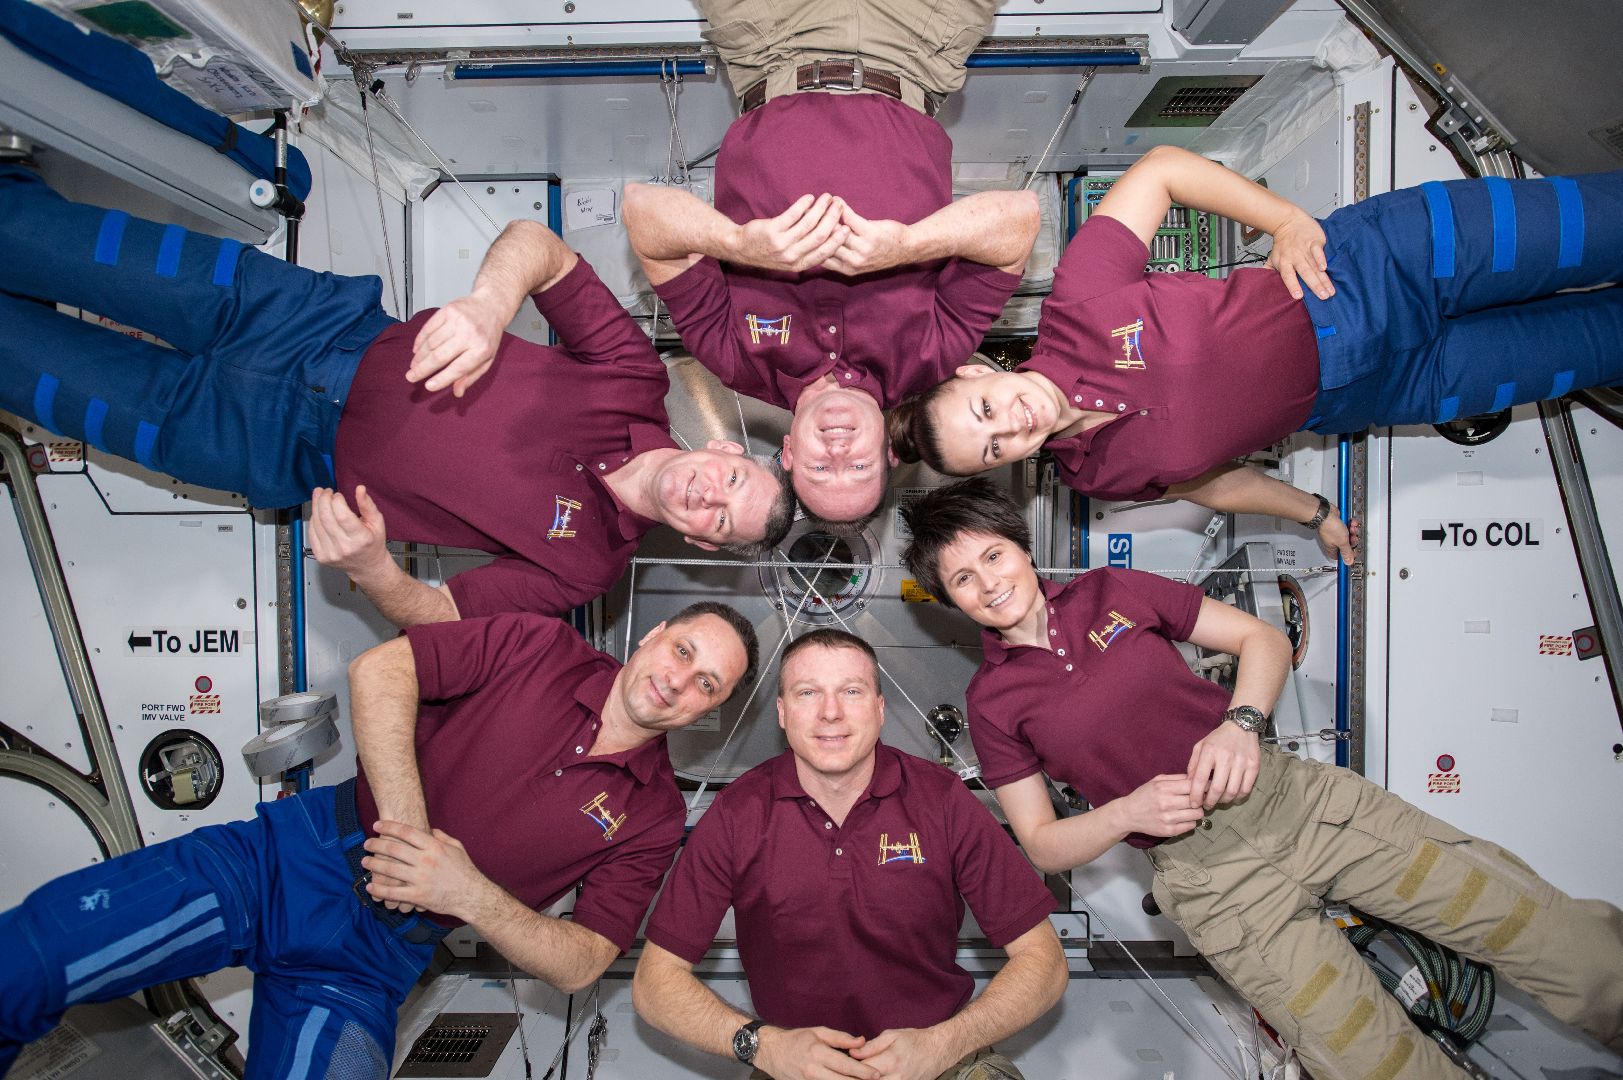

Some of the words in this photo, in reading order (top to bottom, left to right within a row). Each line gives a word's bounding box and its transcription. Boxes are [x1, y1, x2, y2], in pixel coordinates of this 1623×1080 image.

[1449, 523, 1477, 546] To
[1486, 522, 1539, 546] COL
[153, 630, 181, 653] To
[189, 630, 239, 653] JEM
